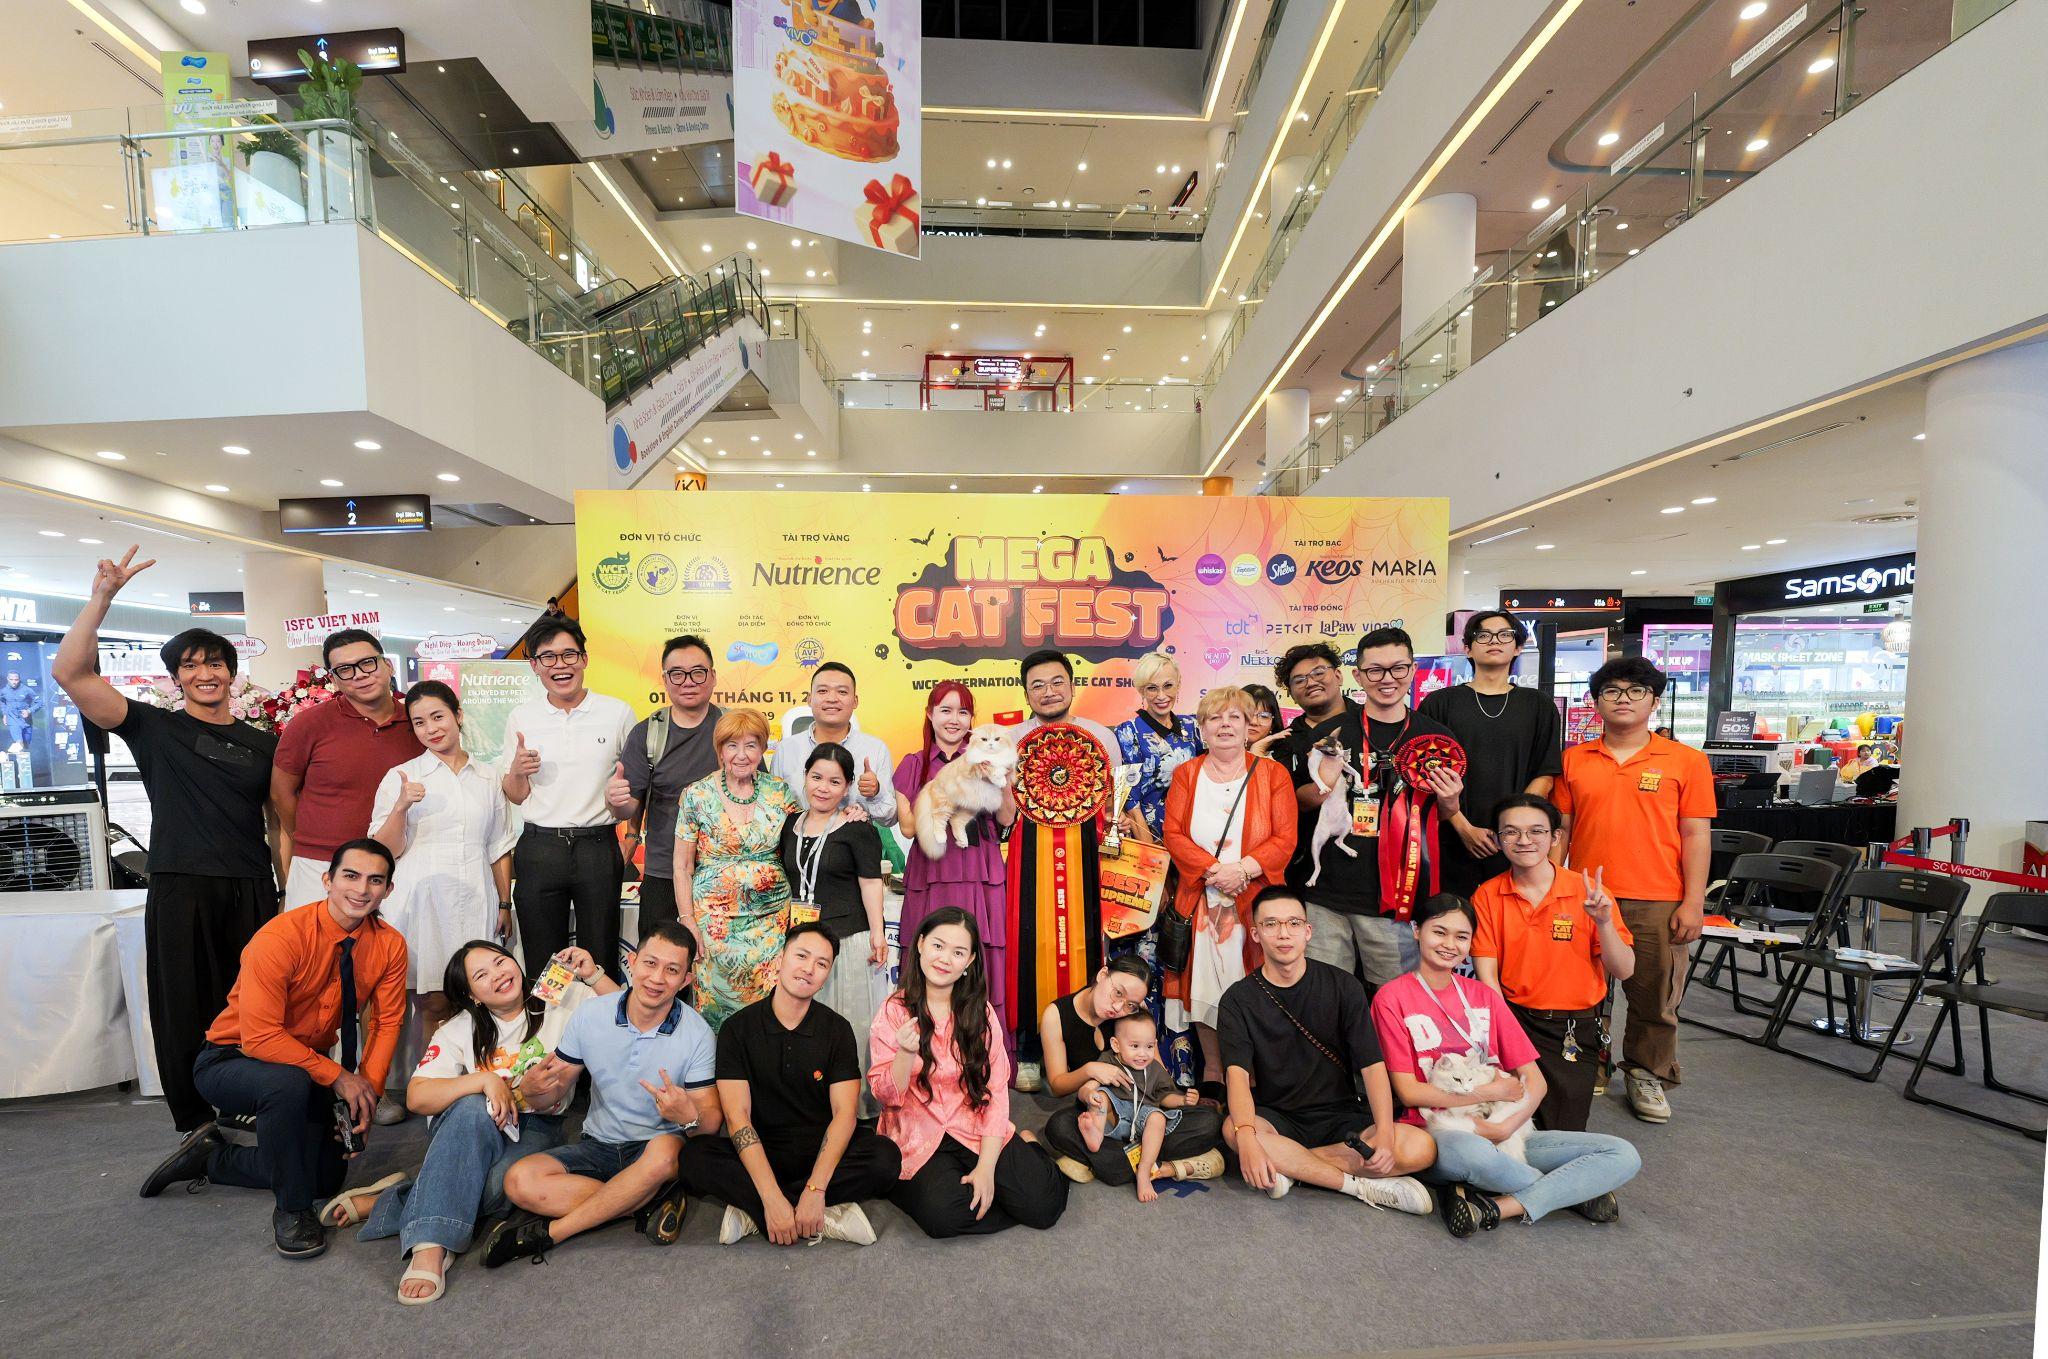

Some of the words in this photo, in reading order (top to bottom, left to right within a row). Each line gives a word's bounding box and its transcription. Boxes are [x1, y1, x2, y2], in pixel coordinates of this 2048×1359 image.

[348, 512, 357, 525] 2
[620, 533, 642, 541] ĐƠN
[645, 533, 655, 543] VỊ
[657, 531, 671, 541] TỔ
[673, 533, 702, 542] CHỨC
[782, 532, 798, 541] TÀI
[800, 533, 820, 543] TRỢ
[822, 532, 850, 542] VÀNG
[1308, 540, 1324, 548] TRỢ
[1326, 540, 1342, 548] BẠC
[599, 564, 629, 574] WCF
[955, 536, 1112, 587] MEGA
[1371, 559, 1437, 576] MARIA
[752, 562, 881, 587] Nutrience
[1197, 567, 1224, 575] whiskas
[1269, 561, 1295, 580] Sheba
[1303, 604, 1319, 613] TRỢ
[1320, 603, 1344, 611] ĐỒNG
[285, 618, 314, 632] ISFC
[352, 611, 380, 625] NAM
[896, 587, 1012, 648] CAT
[1021, 587, 1170, 648] FEST
[1266, 623, 1313, 634] PETKIT
[1320, 620, 1357, 637] LaPaw
[1744, 652, 1776, 663] MASK
[1778, 651, 1811, 662] SHEET
[1814, 651, 1844, 662] ZONE
[460, 673, 530, 687] Nutrience
[1091, 677, 1112, 687] CAT
[649, 691, 666, 704] 01
[714, 689, 774, 704] THÁNG
[778, 691, 796, 705] 11,
[1721, 724, 1750, 733] 50%
[1357, 815, 1374, 824] 078
[1408, 840, 1418, 870] ADULT
[1932, 861, 1948, 872] SC
[1951, 864, 1992, 880] VivoCity
[1101, 870, 1151, 898] BEST
[1404, 870, 1415, 892] RING
[1057, 888, 1066, 910] BEST
[1100, 887, 1153, 914] UPREME
[1058, 915, 1067, 955] SUPREME
[546, 977, 565, 991] 072
